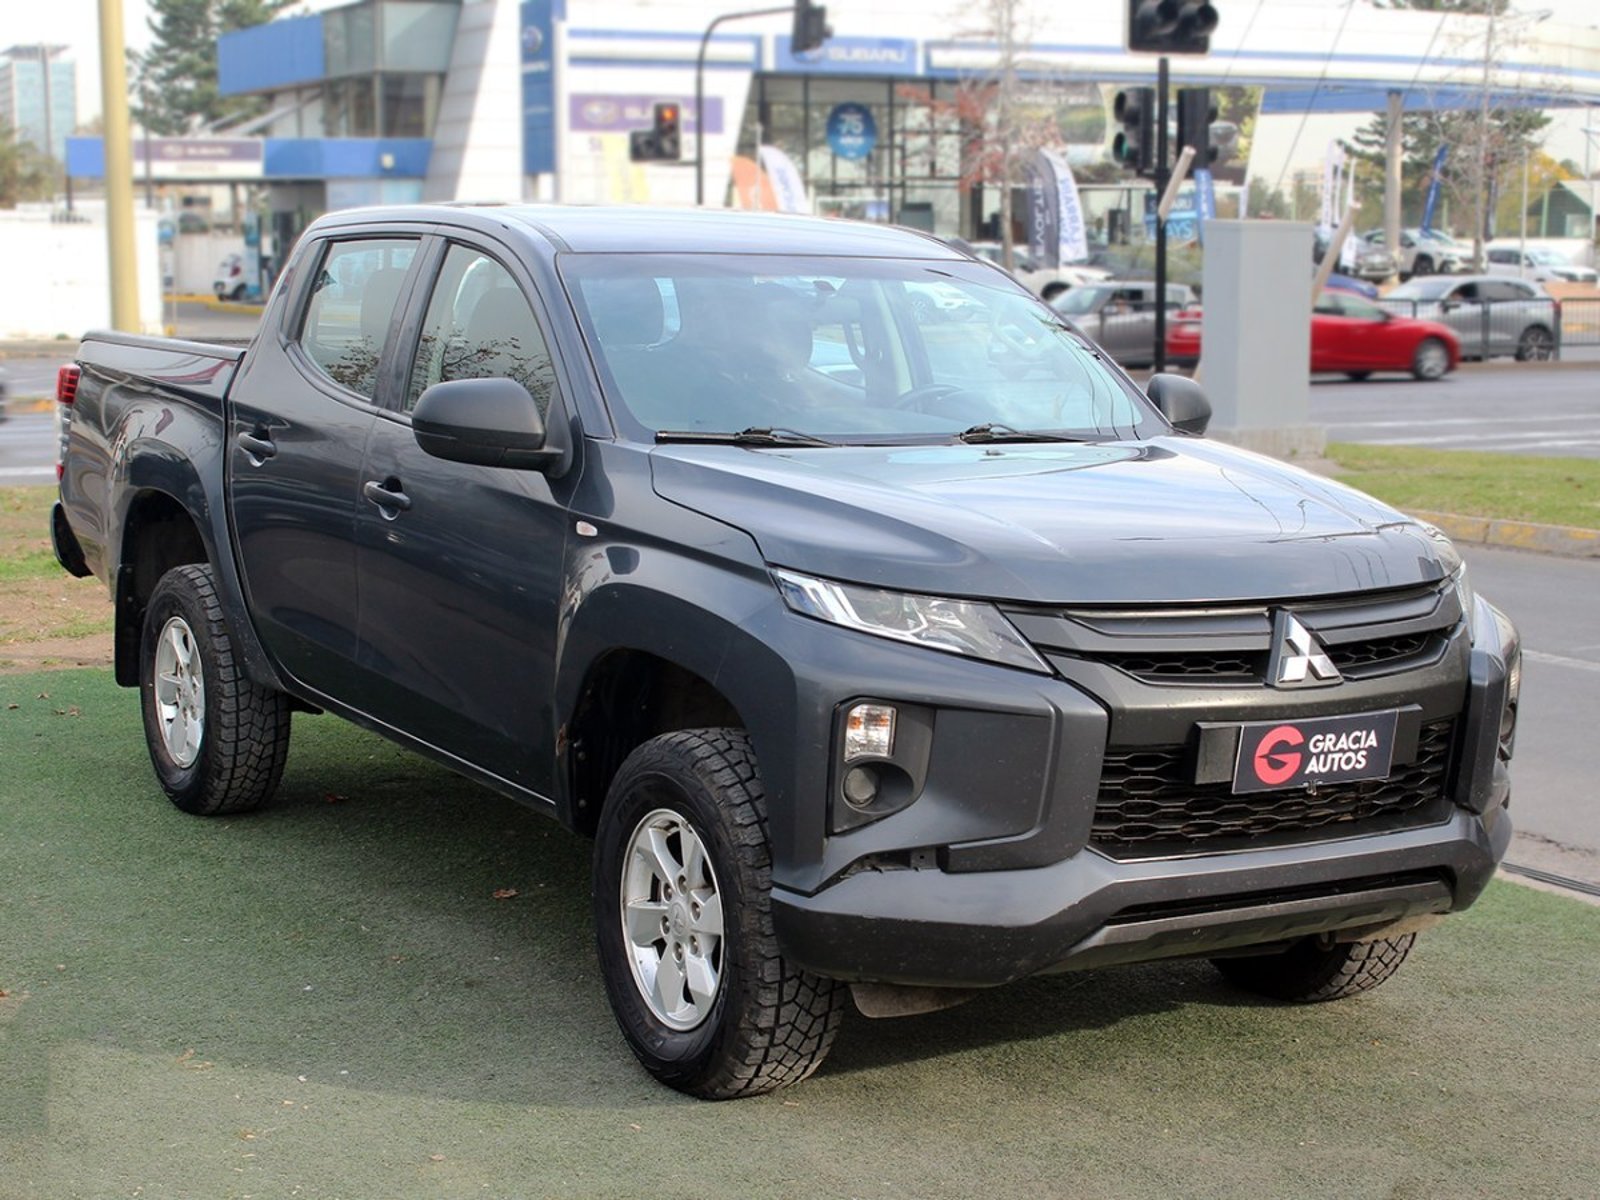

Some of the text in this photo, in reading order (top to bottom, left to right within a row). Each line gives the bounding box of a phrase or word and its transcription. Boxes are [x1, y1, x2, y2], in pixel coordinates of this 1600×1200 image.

[828, 48, 905, 63] SUBARU
[1309, 729, 1377, 753] GRACIA
[1304, 751, 1367, 774] AUTOS
